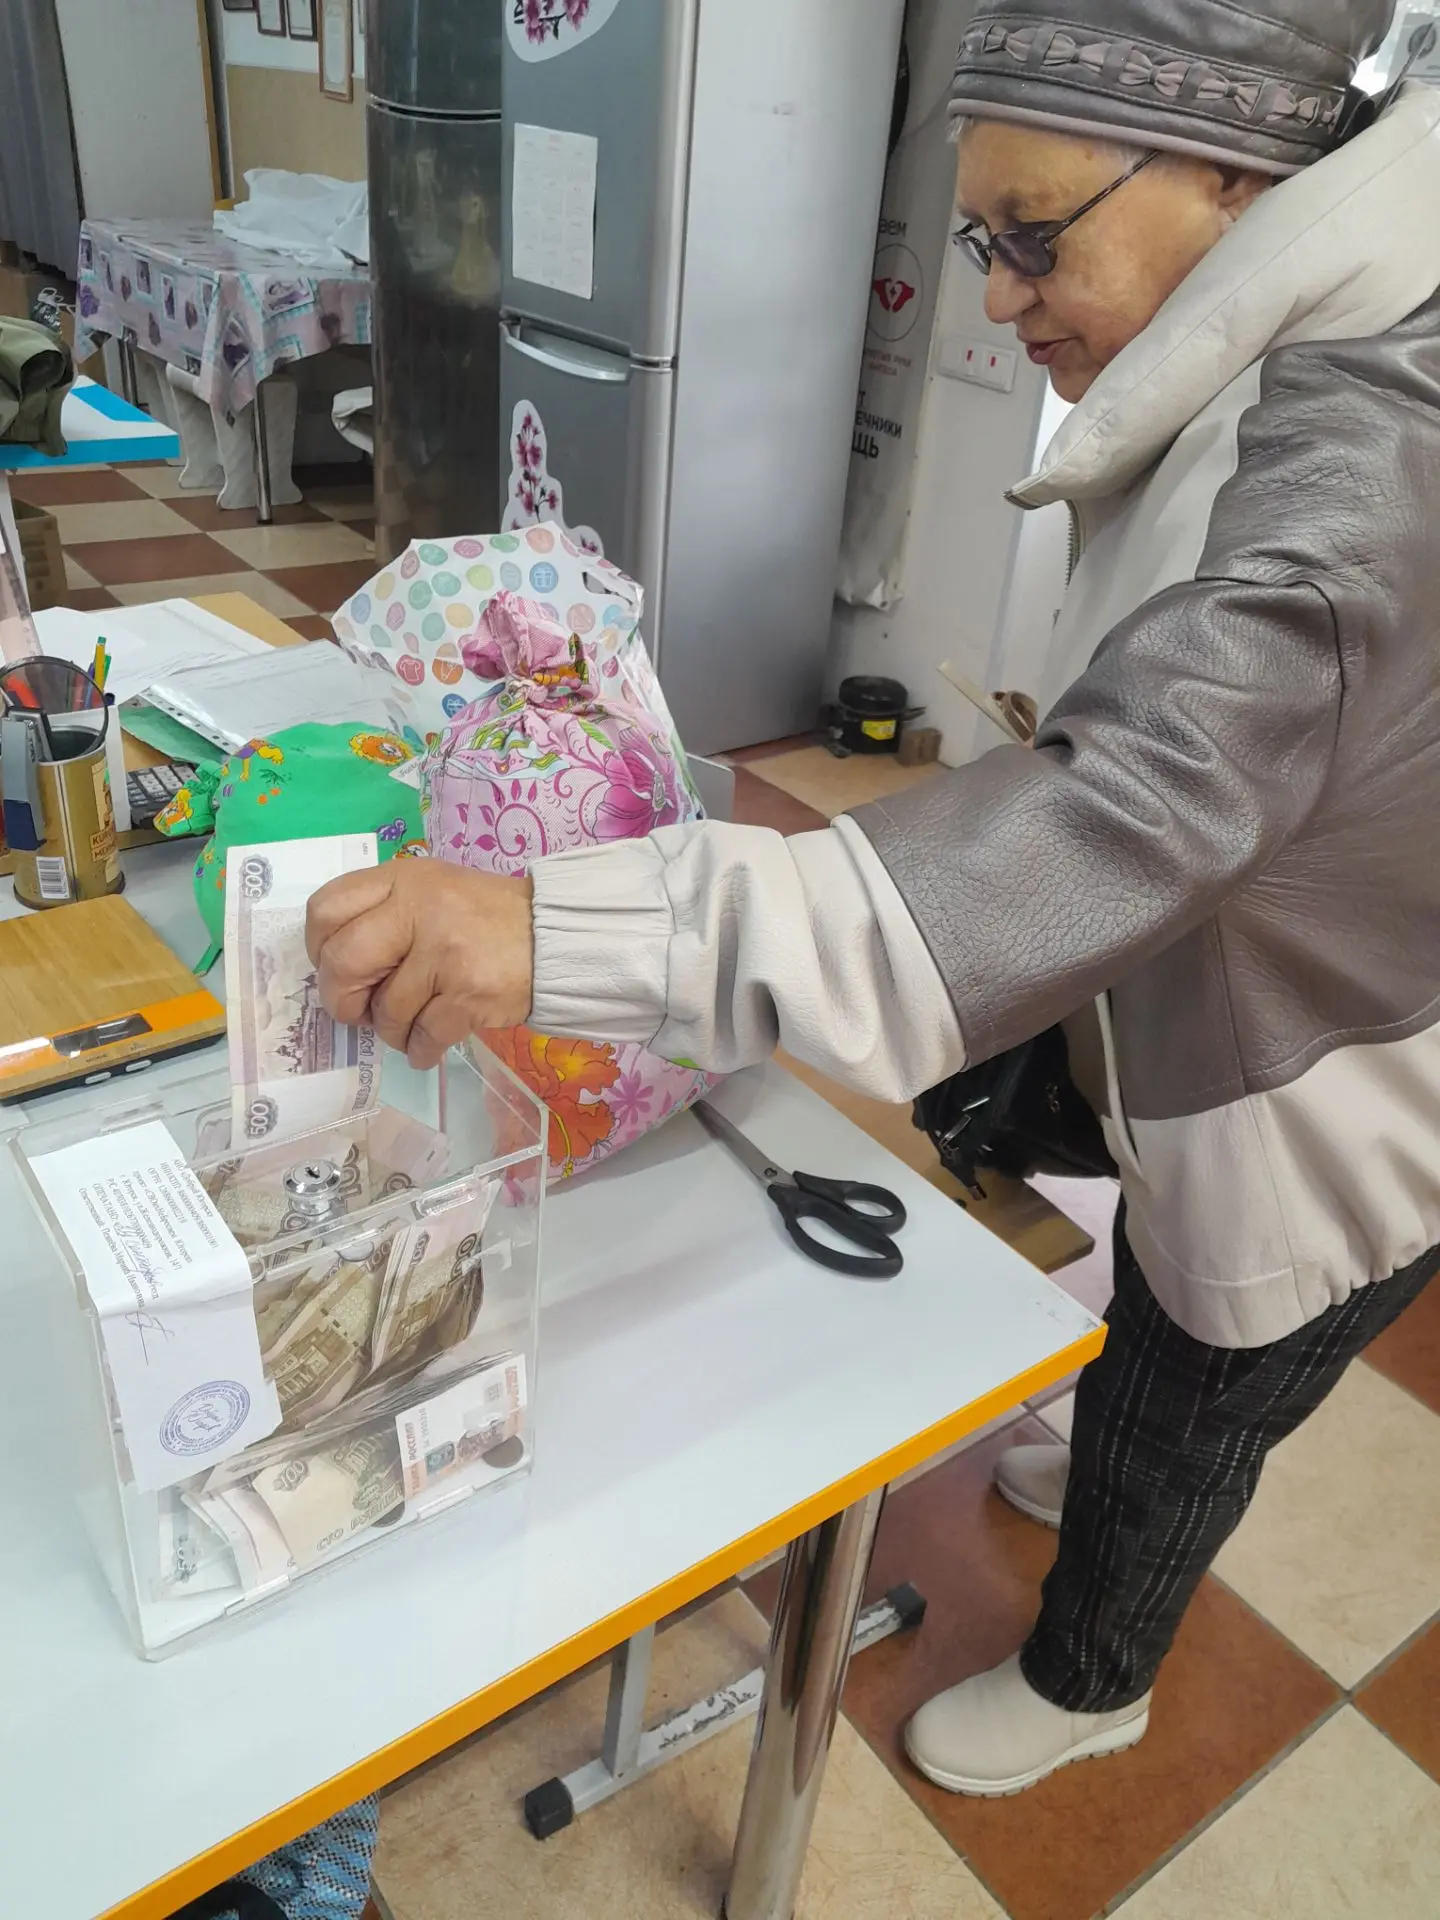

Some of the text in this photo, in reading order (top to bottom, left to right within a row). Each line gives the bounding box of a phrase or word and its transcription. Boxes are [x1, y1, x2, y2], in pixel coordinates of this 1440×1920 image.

[244, 861, 265, 901] 500
[249, 1101, 270, 1136] 500
[281, 1459, 307, 1488] 100
